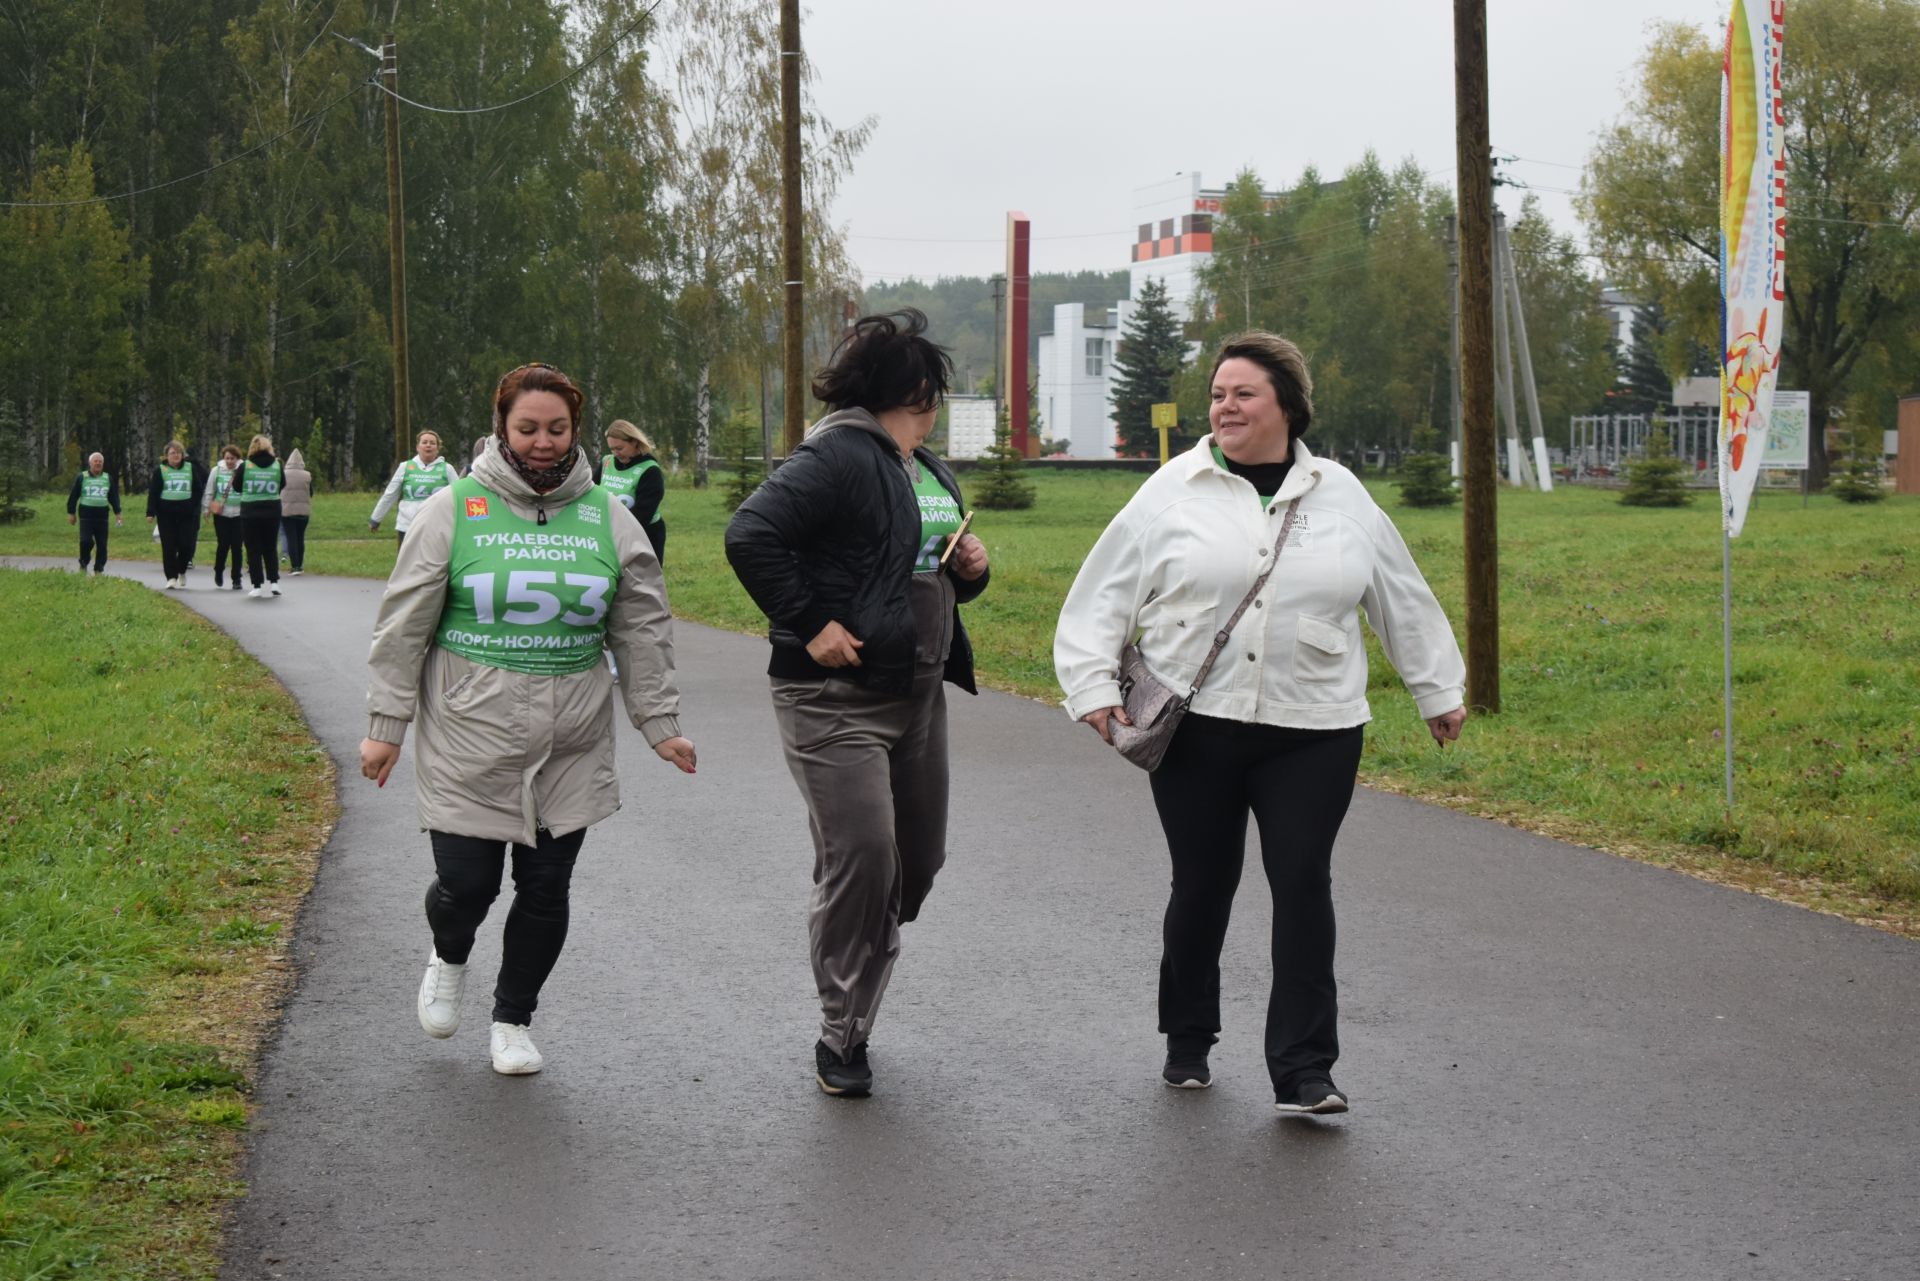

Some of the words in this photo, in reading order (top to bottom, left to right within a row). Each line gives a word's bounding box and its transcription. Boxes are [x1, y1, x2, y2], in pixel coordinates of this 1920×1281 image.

[1762, 23, 1773, 156] СПОРТОМ
[1764, 165, 1774, 299] ЗАЙМИСЬ
[164, 479, 190, 492] 171
[245, 480, 278, 494] 170
[921, 507, 957, 523] АЙОН
[473, 532, 599, 553] ТУКАЕВСКИЙ
[503, 545, 577, 562] РАЙОН
[462, 570, 610, 627] 153
